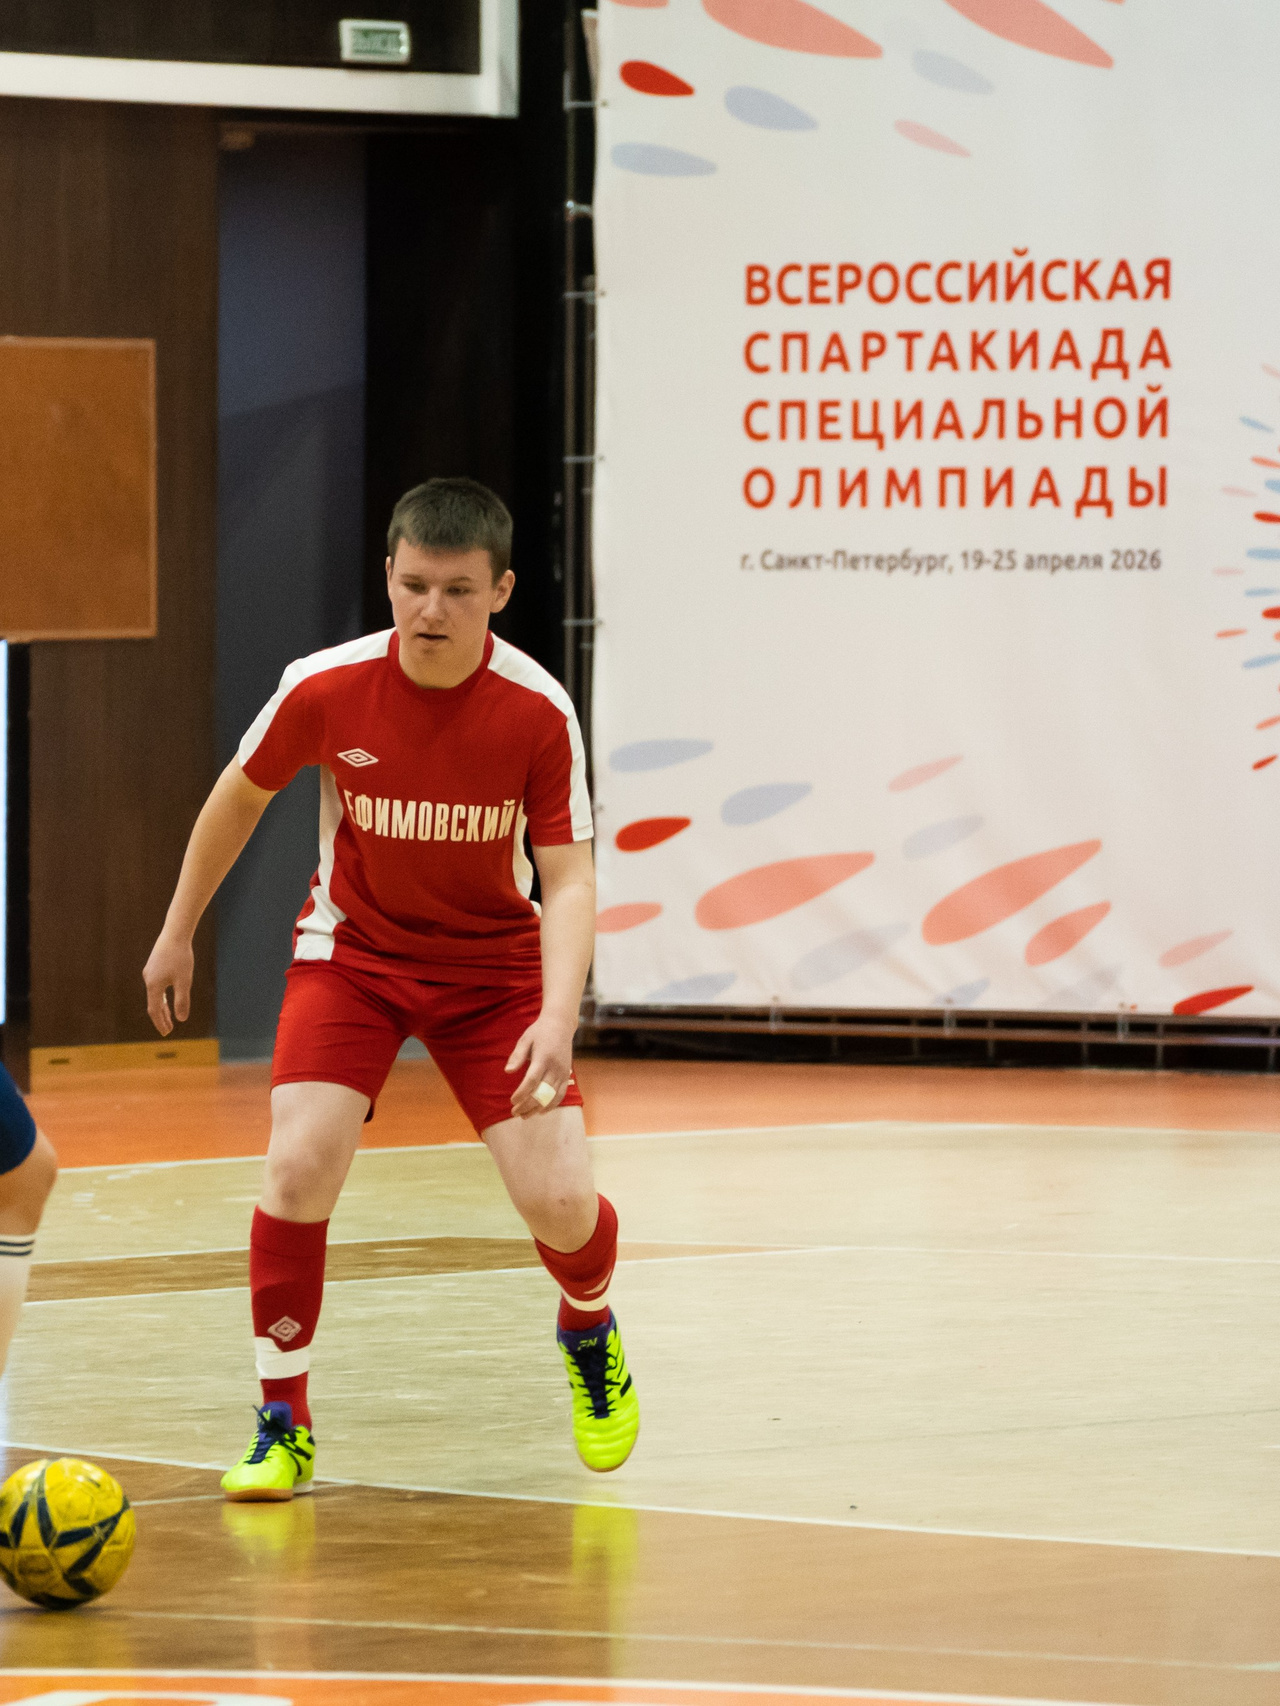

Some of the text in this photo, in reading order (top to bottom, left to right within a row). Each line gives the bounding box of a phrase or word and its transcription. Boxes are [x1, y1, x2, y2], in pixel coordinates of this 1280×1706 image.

[745, 247, 1171, 306] ВСЕРОССИЙСКАЯ
[743, 327, 1172, 381] СПАРТАКИАДА
[743, 384, 1169, 451] СПЕЦИАЛЬНОЙ
[743, 466, 1167, 519] ОЛИМПИАДЫ
[740, 548, 1162, 576] г. Санкт-Петербург, 19-25 апреля 2026
